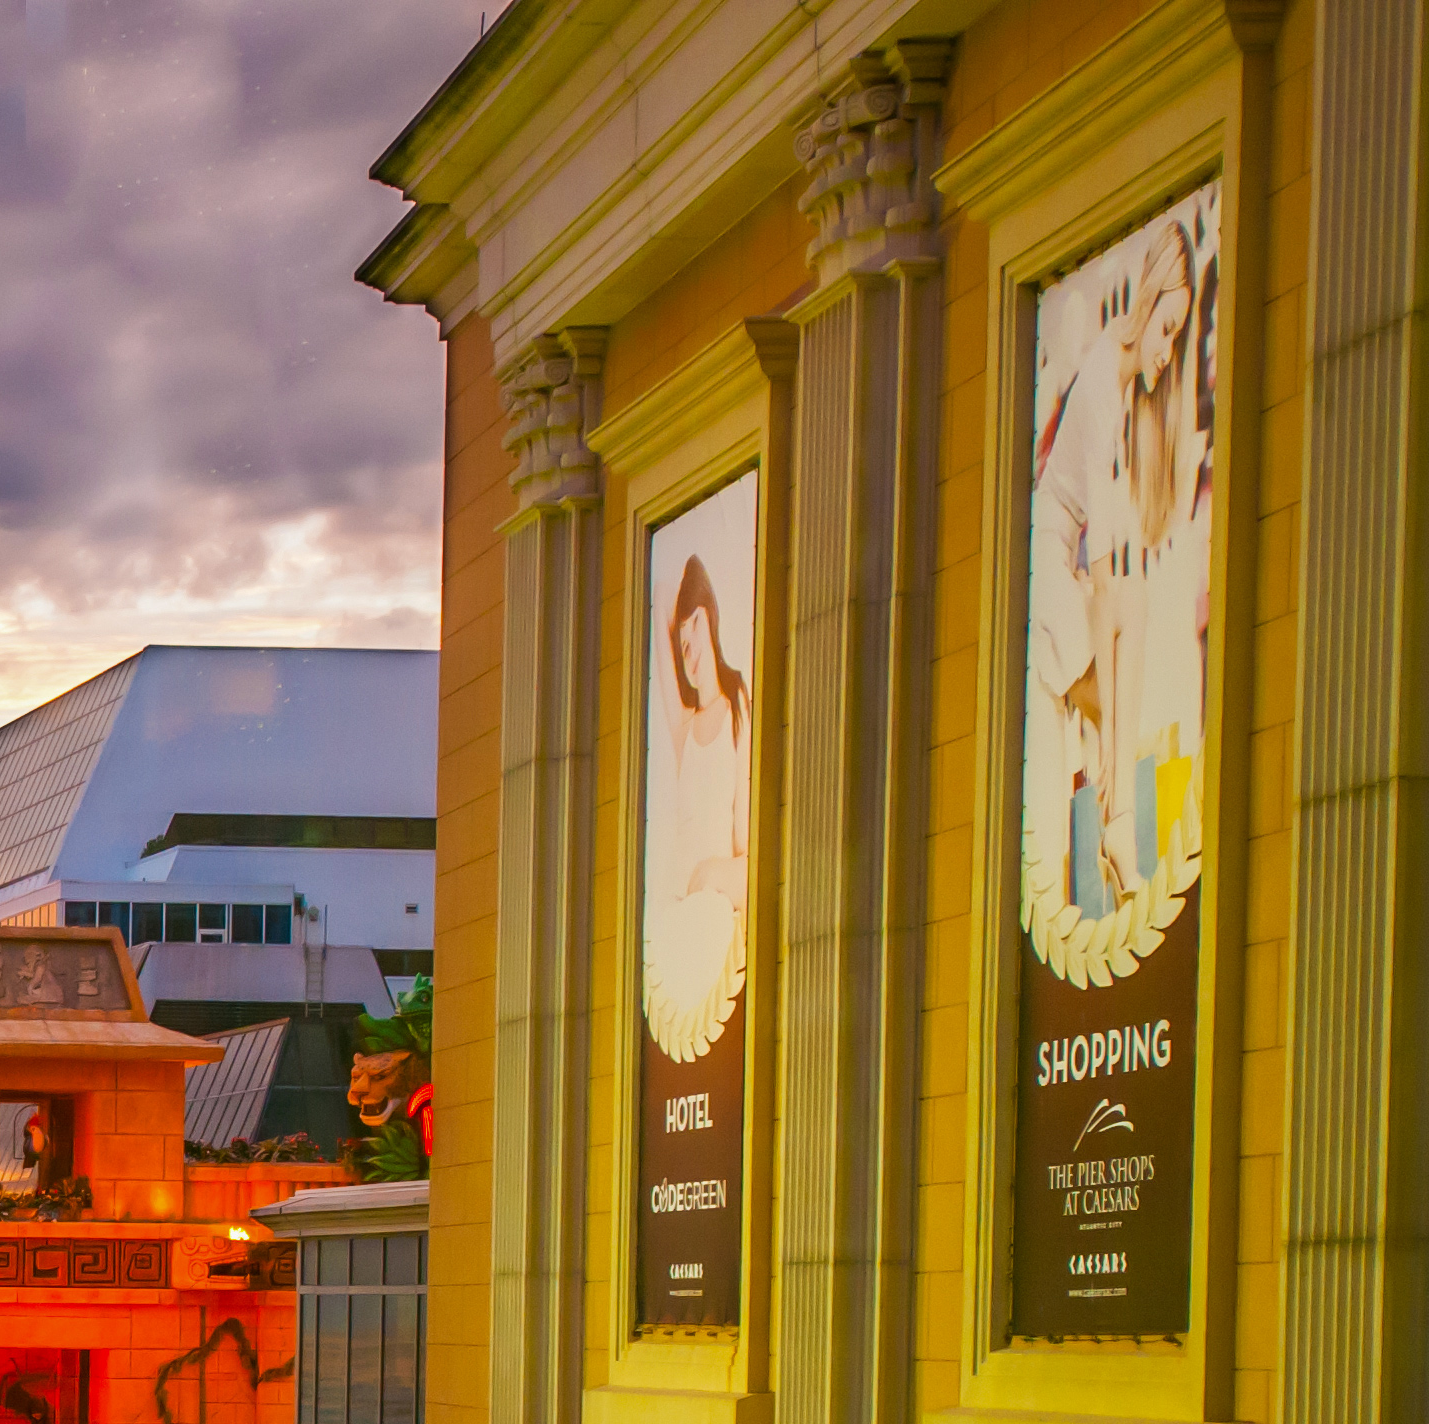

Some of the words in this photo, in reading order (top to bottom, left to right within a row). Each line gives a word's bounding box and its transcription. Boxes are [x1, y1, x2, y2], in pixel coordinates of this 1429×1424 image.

[1037, 1019, 1172, 1087] SHOPPING
[665, 1093, 714, 1133] HOTEL
[1048, 1164, 1074, 1190] THE
[1077, 1160, 1106, 1187] PIER
[1109, 1154, 1155, 1184] SHOPS
[1063, 1191, 1080, 1216] AT
[1083, 1185, 1140, 1215] CAESARS
[669, 1263, 704, 1280] CAESARS
[1068, 1252, 1128, 1275] CAESARS
